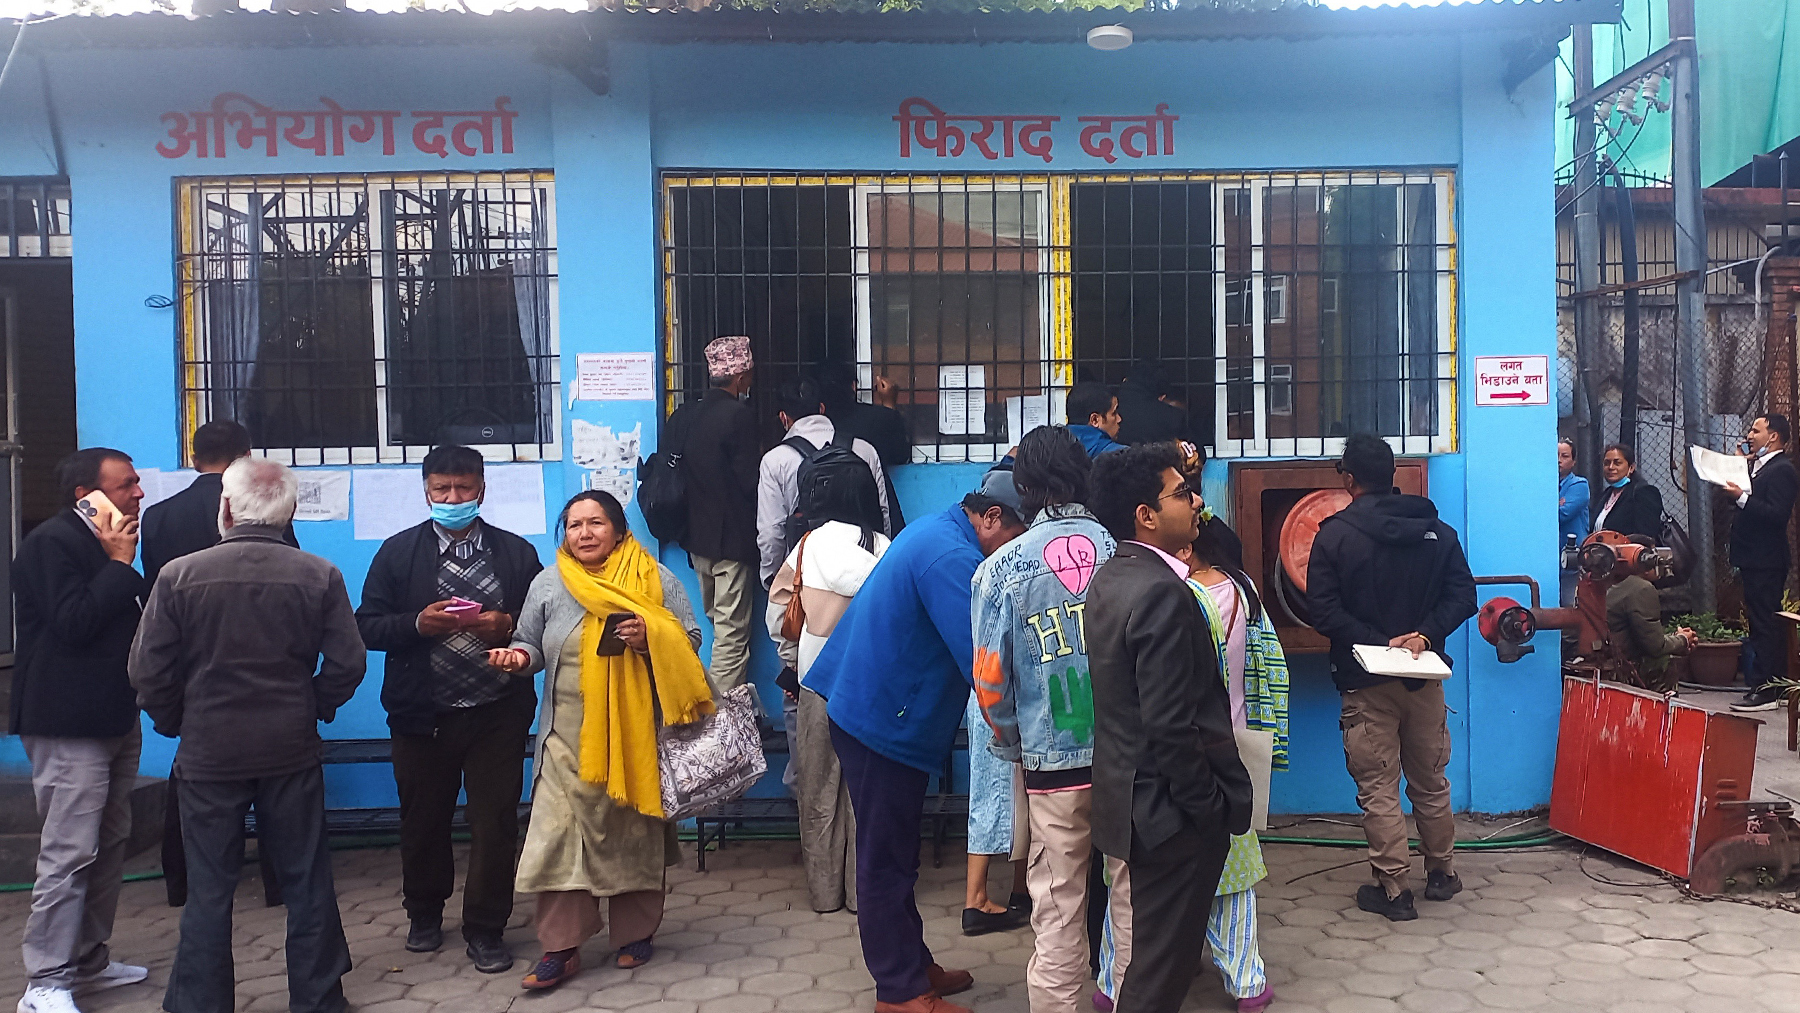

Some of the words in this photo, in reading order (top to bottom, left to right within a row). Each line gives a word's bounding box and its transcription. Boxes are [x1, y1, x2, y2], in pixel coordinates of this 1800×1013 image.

[155, 91, 401, 159] अभियोग
[410, 95, 518, 158] दर्ता
[892, 96, 1061, 163] फिराद
[1077, 103, 1179, 164] दर्ता
[1480, 372, 1520, 387] भिडाउने
[1500, 361, 1523, 372] लगत
